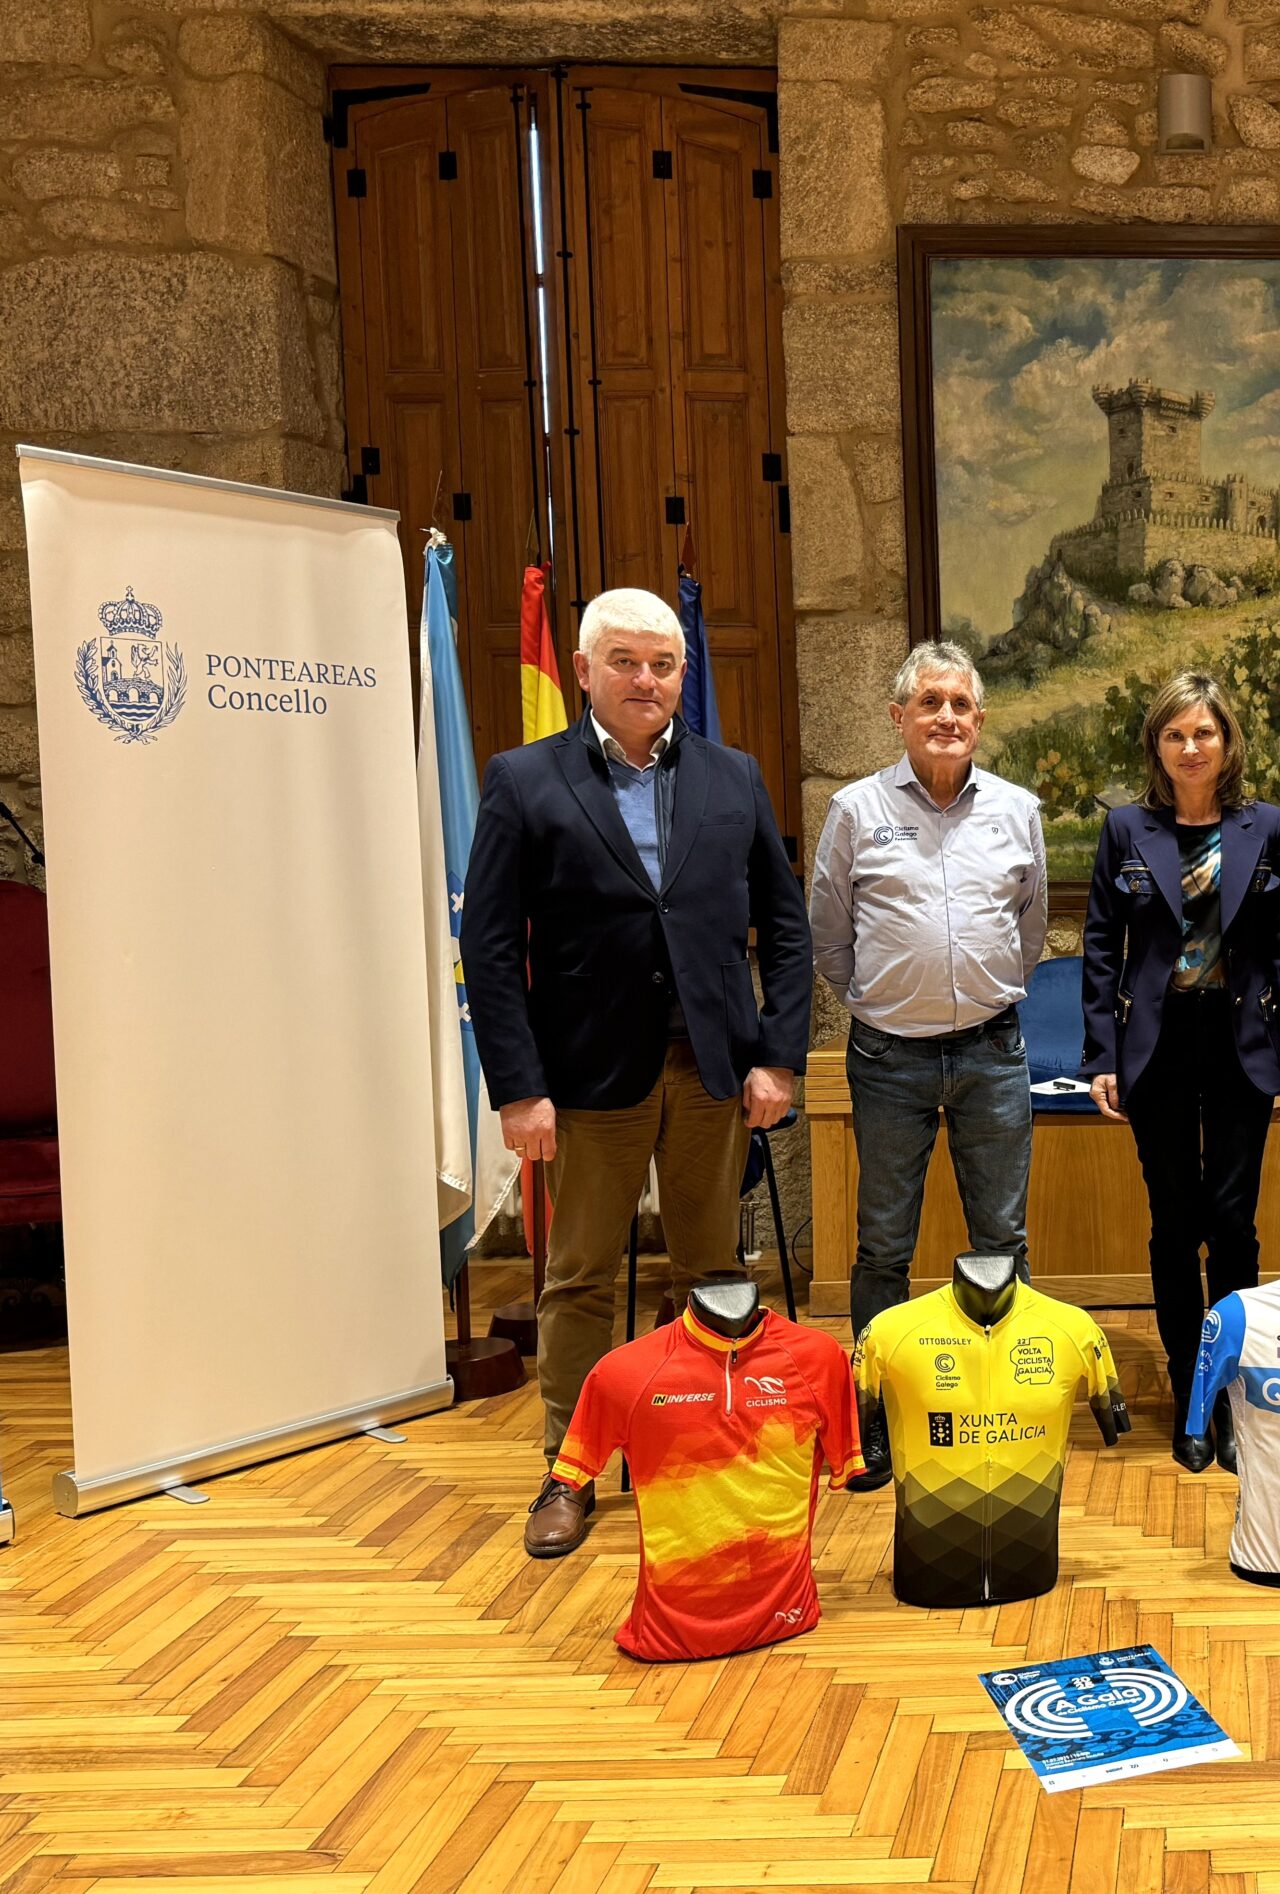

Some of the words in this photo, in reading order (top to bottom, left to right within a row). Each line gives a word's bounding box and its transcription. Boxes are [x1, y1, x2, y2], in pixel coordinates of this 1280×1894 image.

[206, 654, 377, 688] PONTEAREAS
[208, 684, 327, 714] Concello
[919, 1337, 972, 1346] OTTOBOSLEY
[1017, 1347, 1042, 1355] VOLTA
[1017, 1356, 1052, 1365] CICLISTA
[935, 1381, 959, 1389] Galego
[667, 1392, 716, 1404] INVERSE
[746, 1397, 787, 1408] CICLISMO
[960, 1412, 1018, 1428] XUNTA
[959, 1430, 980, 1444] DE
[986, 1425, 1046, 1444] GALICIA
[1055, 1699, 1077, 1712] A
[1077, 1688, 1140, 1706] Gala
